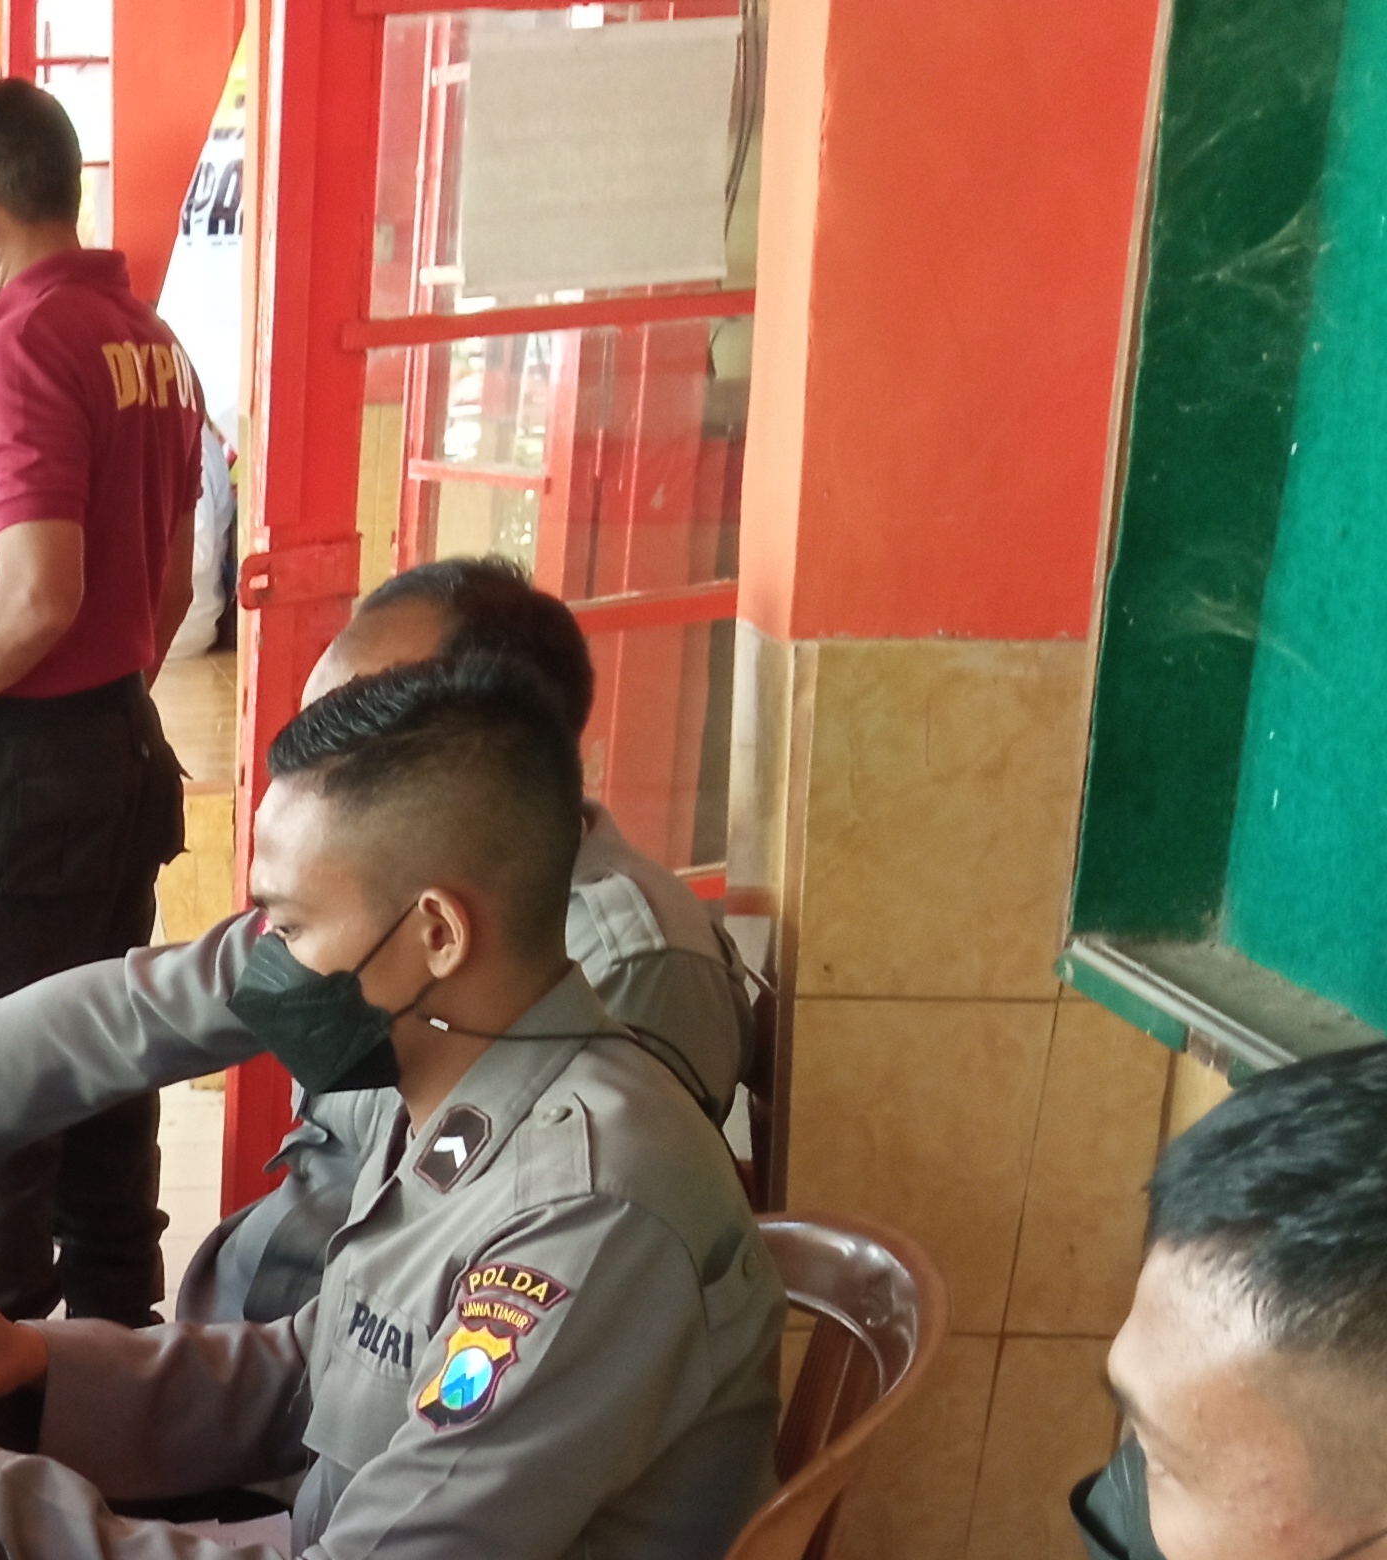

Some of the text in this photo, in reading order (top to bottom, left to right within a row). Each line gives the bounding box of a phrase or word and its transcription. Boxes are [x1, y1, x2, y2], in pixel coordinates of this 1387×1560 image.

[467, 1265, 551, 1303] POLDA
[348, 1301, 414, 1369] POLRI
[461, 1301, 530, 1331] JAWA TIMUR
